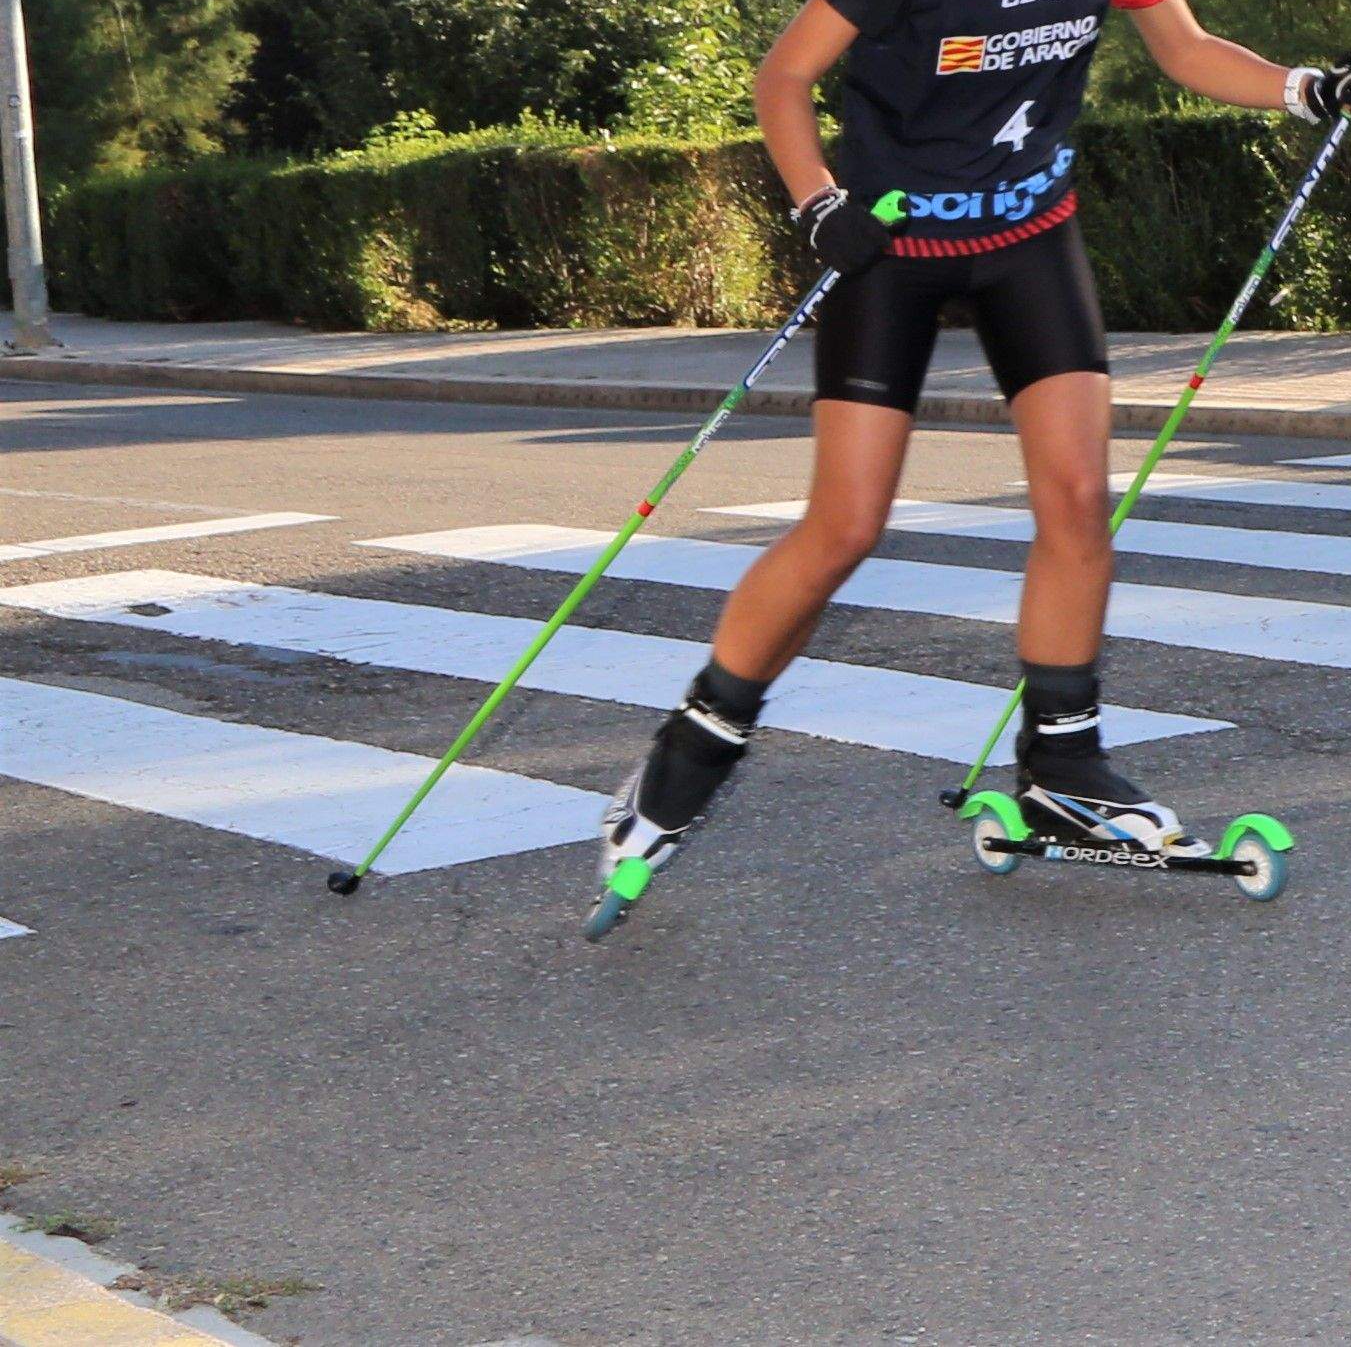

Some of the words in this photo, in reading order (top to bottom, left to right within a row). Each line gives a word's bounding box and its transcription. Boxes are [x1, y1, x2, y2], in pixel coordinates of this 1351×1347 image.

[984, 54, 1015, 71] DE
[1019, 28, 1099, 66] ARAG
[986, 15, 1097, 53] GOBIERNO
[992, 100, 1035, 152] 4
